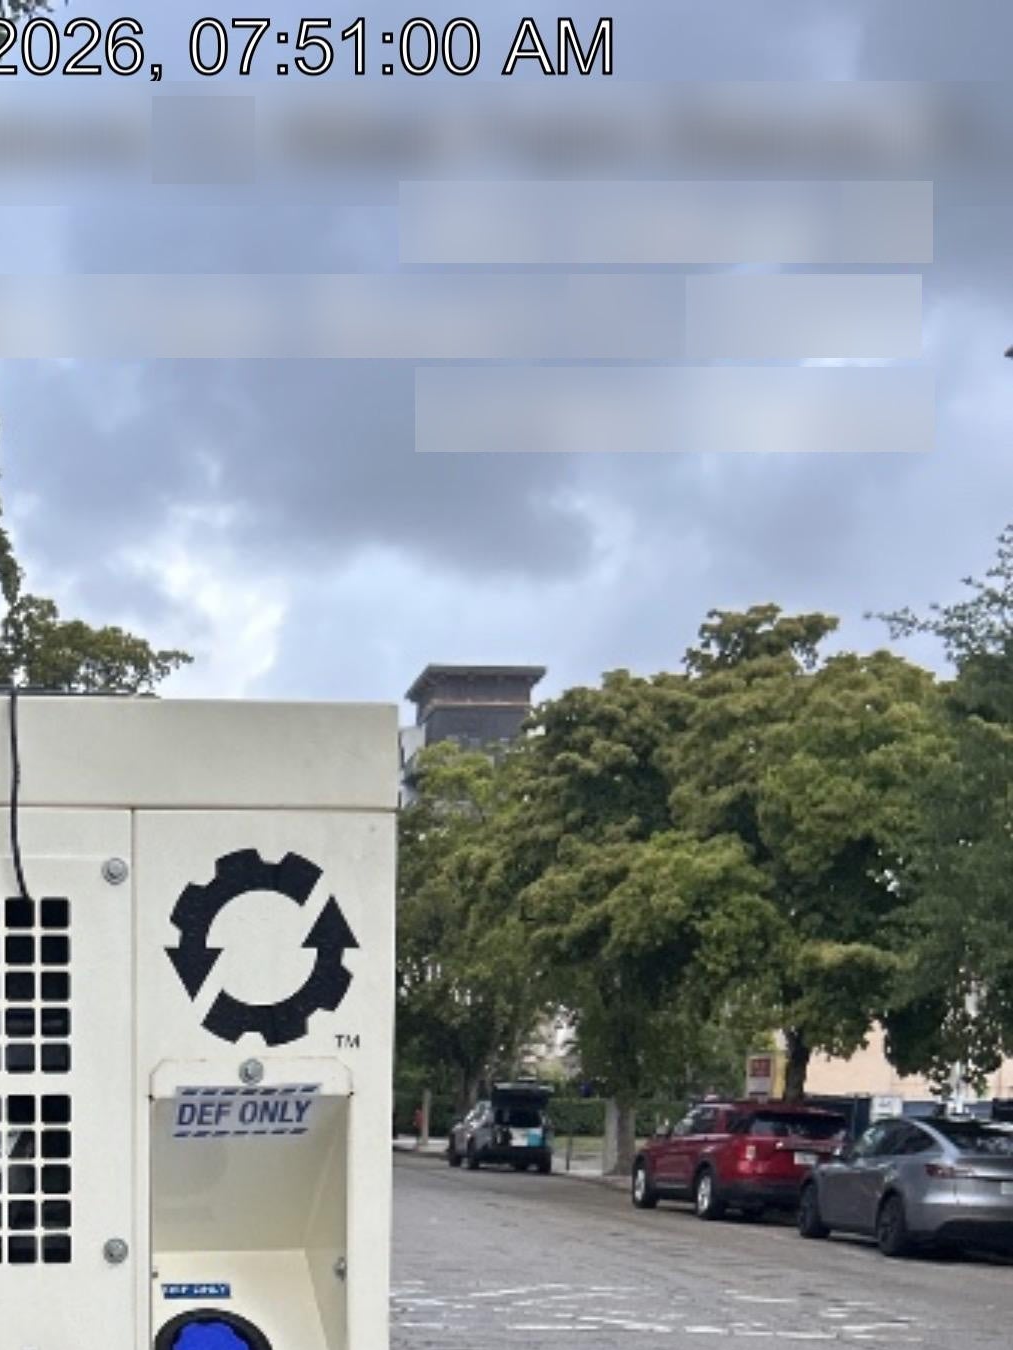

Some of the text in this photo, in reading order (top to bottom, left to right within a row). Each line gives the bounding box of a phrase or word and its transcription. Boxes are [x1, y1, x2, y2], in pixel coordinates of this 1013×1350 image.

[335, 1034, 361, 1048] TM
[176, 1099, 313, 1127] DEF ONLY
